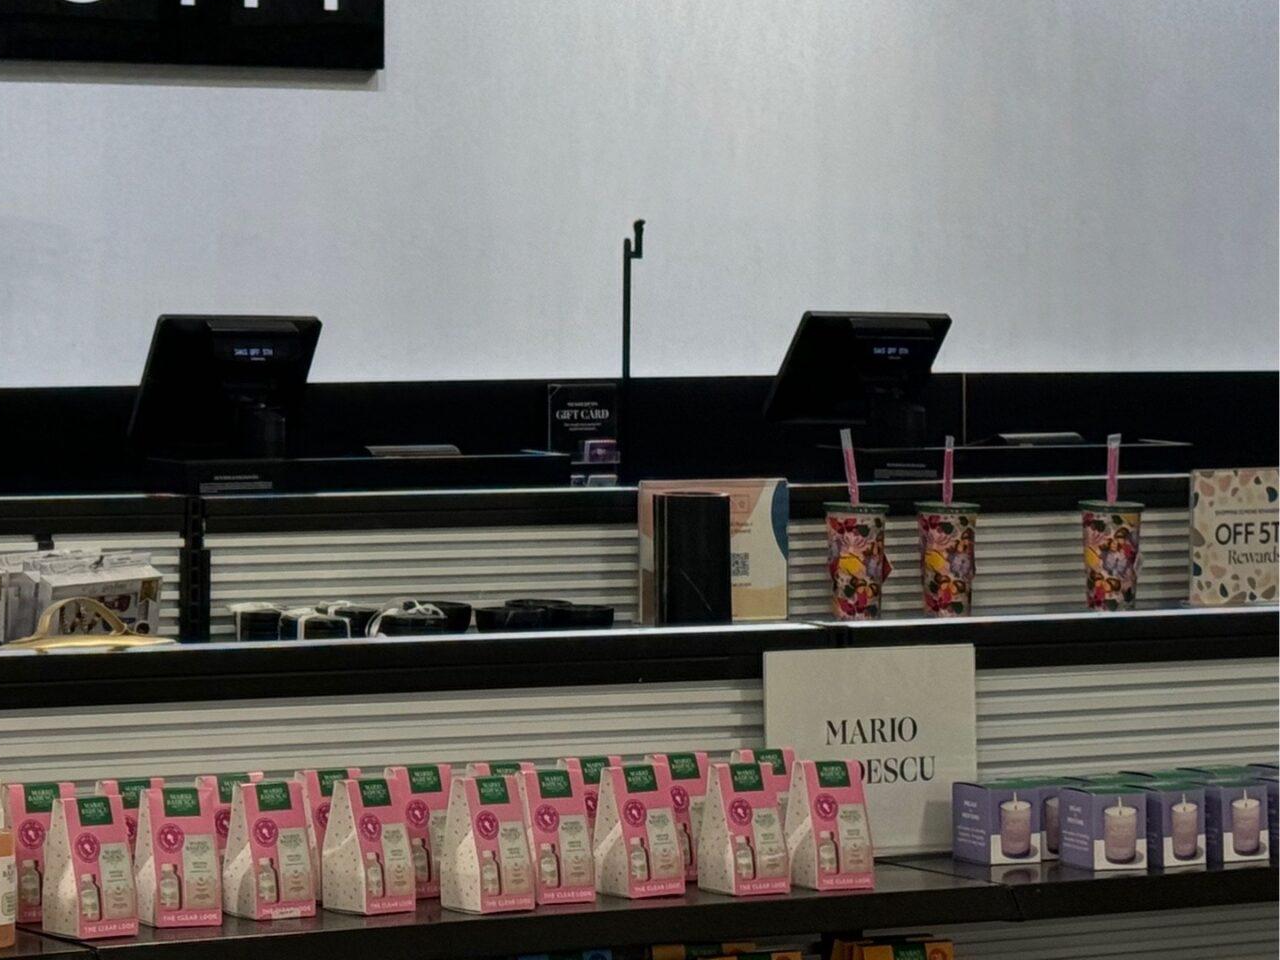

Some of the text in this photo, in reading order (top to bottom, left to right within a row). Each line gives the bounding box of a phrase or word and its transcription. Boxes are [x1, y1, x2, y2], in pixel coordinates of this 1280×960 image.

[555, 408, 610, 420] GIFT CARD
[1215, 522, 1255, 545] OFF
[826, 716, 918, 746] MARIO
[858, 756, 935, 785] ESCU
